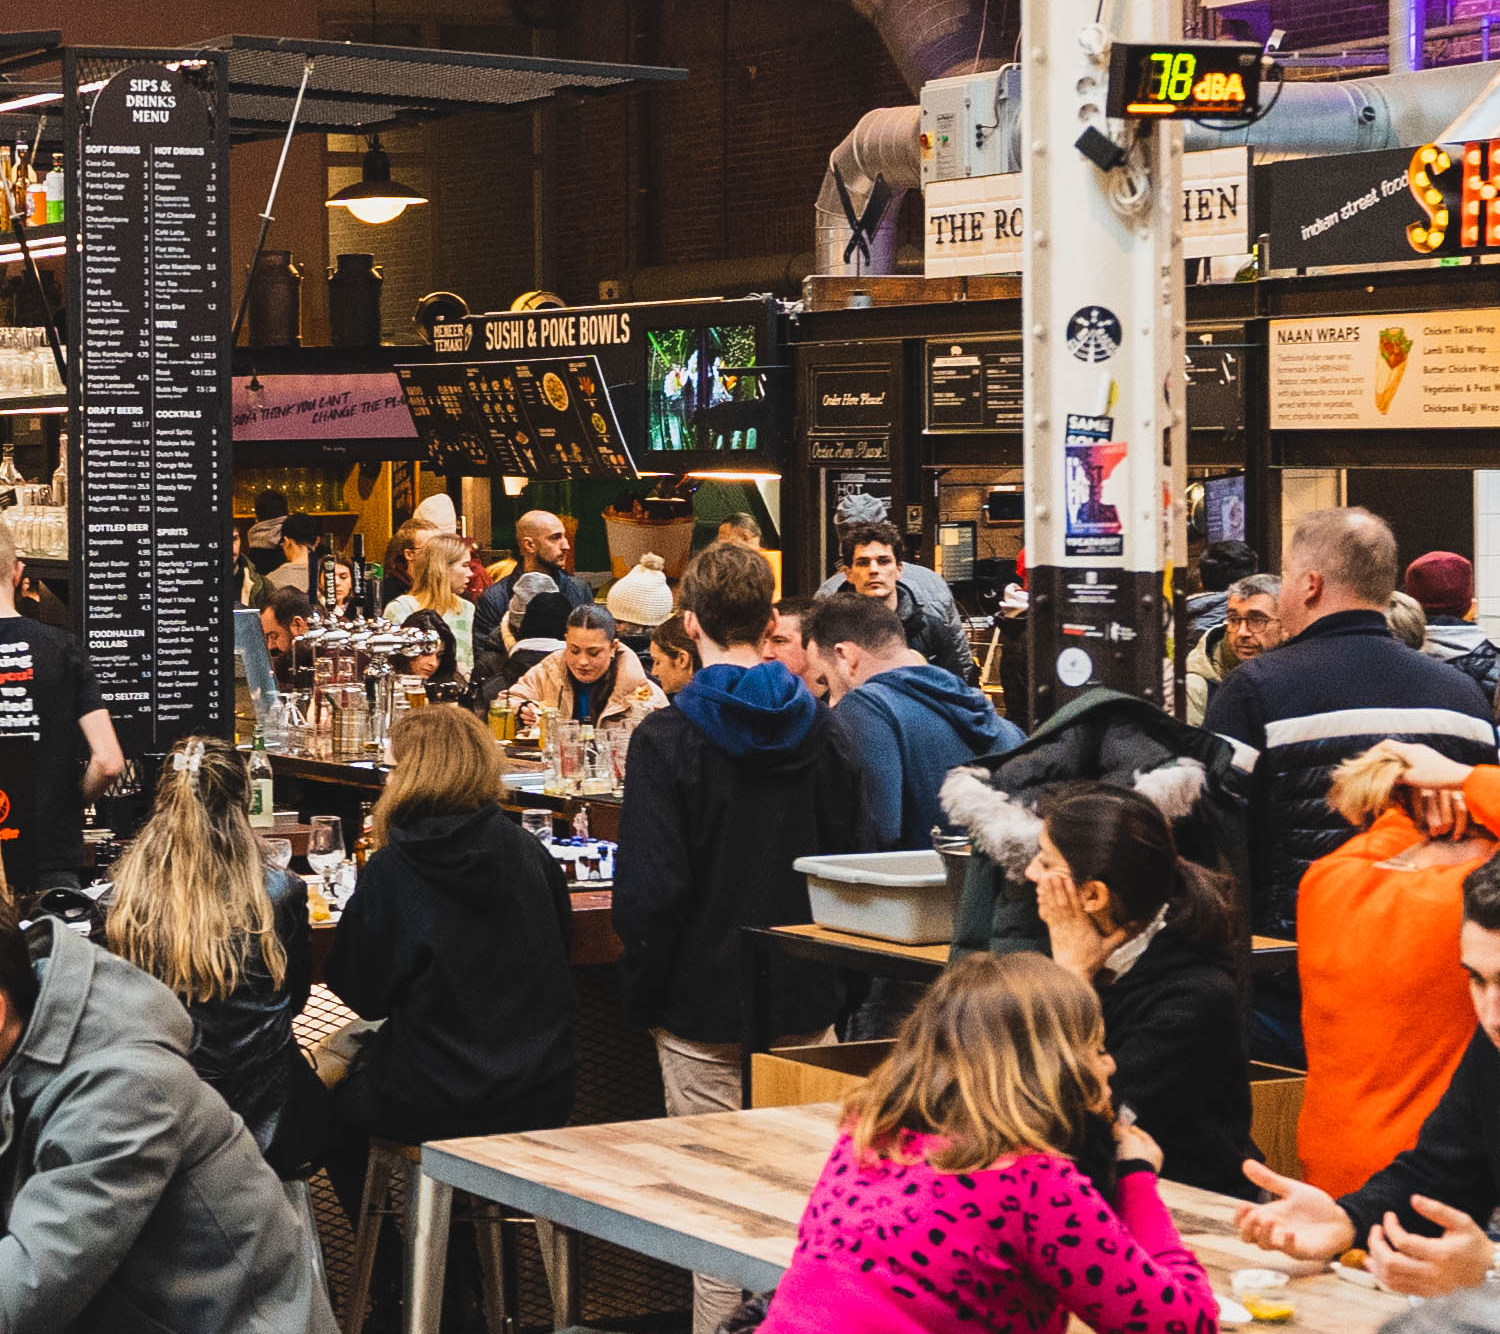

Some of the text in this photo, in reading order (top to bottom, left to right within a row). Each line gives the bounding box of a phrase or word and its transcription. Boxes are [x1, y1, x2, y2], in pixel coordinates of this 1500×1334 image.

[1151, 53, 1246, 101] 78 dBA
[130, 79, 172, 92] SIPS &
[126, 95, 176, 108] DRINKS
[132, 110, 170, 123] MENU
[85, 145, 140, 154] SOFT DRINKS
[154, 147, 204, 156] HOT DRINKS
[1301, 169, 1409, 241] indian street food
[930, 212, 985, 245] THE
[485, 313, 630, 351] SUSHI & POKE BOWLS
[1277, 327, 1361, 343] NAAN WRAPS
[1423, 325, 1453, 336] Chicken
[1454, 325, 1473, 335] Tikka
[1475, 325, 1496, 336] Wrap
[1423, 345, 1443, 355] Lamb
[1445, 345, 1465, 354] Tikka
[1467, 344, 1486, 355] Wrap
[1423, 364, 1446, 374] Butter
[1448, 363, 1477, 373] Chicken
[1479, 363, 1500, 374] Wrap
[1423, 383, 1464, 395] Vegetables
[822, 393, 841, 406] Order
[87, 407, 144, 415] DRAFT BEERS
[261, 405, 294, 421] THINK
[312, 404, 357, 424] CHANGE
[361, 399, 381, 413] THE
[1480, 403, 1500, 413] Wrap
[155, 410, 202, 418] COCKTAILS
[837, 483, 864, 496] HOT
[88, 524, 126, 532] BOTTLED
[157, 528, 188, 536] SPIRITS
[89, 629, 145, 638] FOODHALLEN
[89, 640, 128, 648] COLLABS
[115, 692, 150, 700] SELTZER
